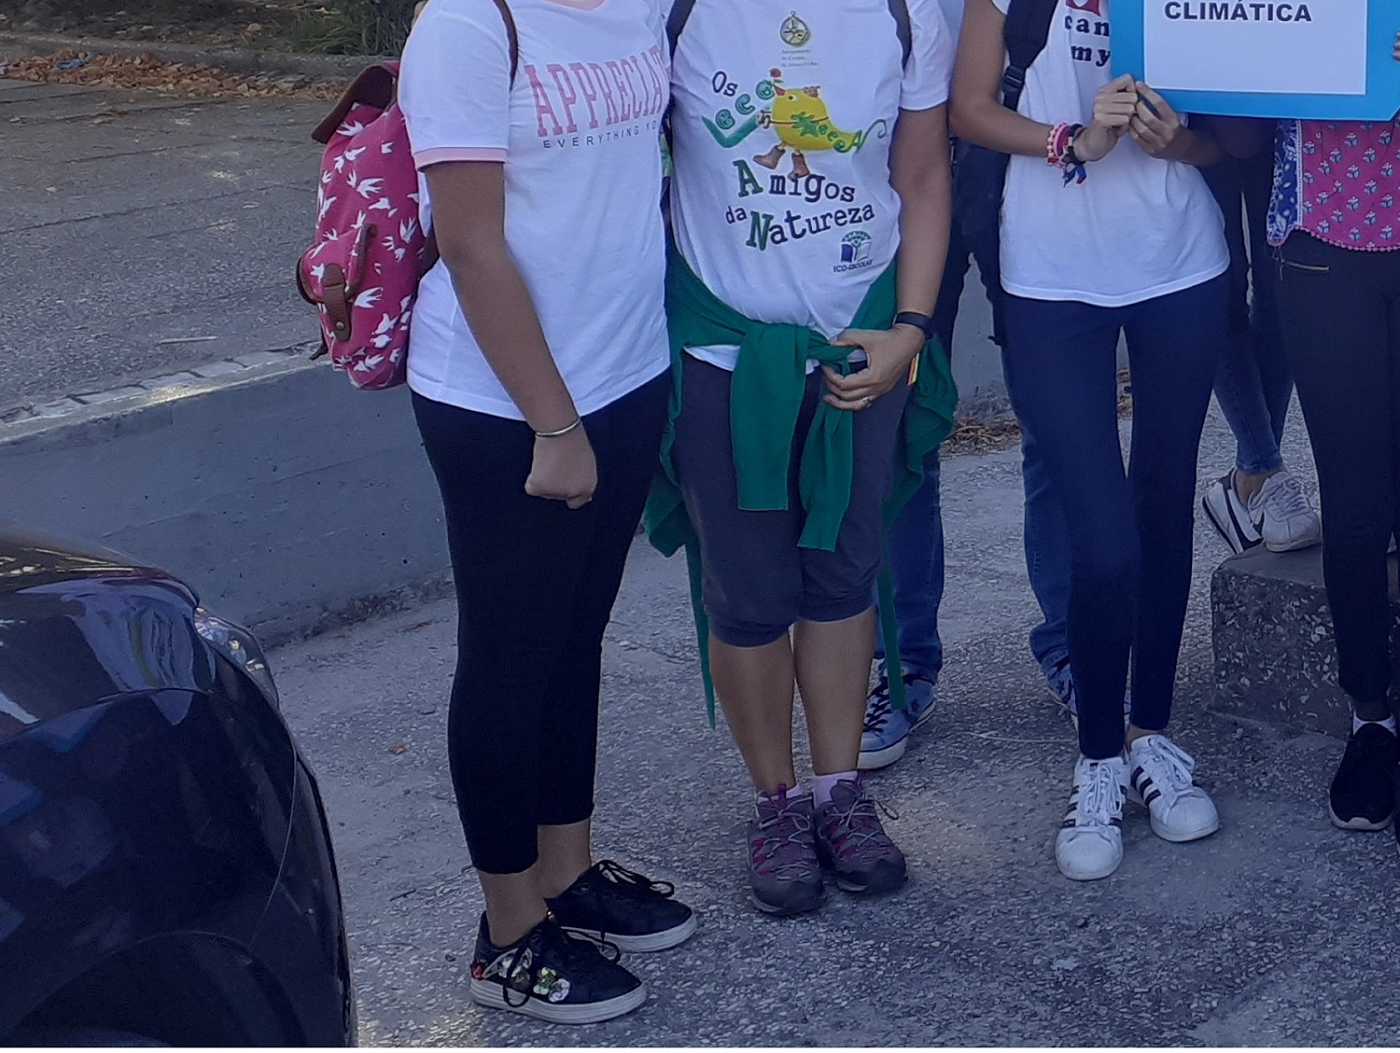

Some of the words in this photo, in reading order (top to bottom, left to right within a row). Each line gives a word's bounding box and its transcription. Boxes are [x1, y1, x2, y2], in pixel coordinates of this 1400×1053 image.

[523, 44, 664, 138] APPRECIAT
[711, 70, 738, 97] Os
[543, 125, 640, 149] EVERYTHING
[733, 159, 856, 203] Amigos
[725, 205, 748, 225] da
[745, 204, 876, 252] Natureza
